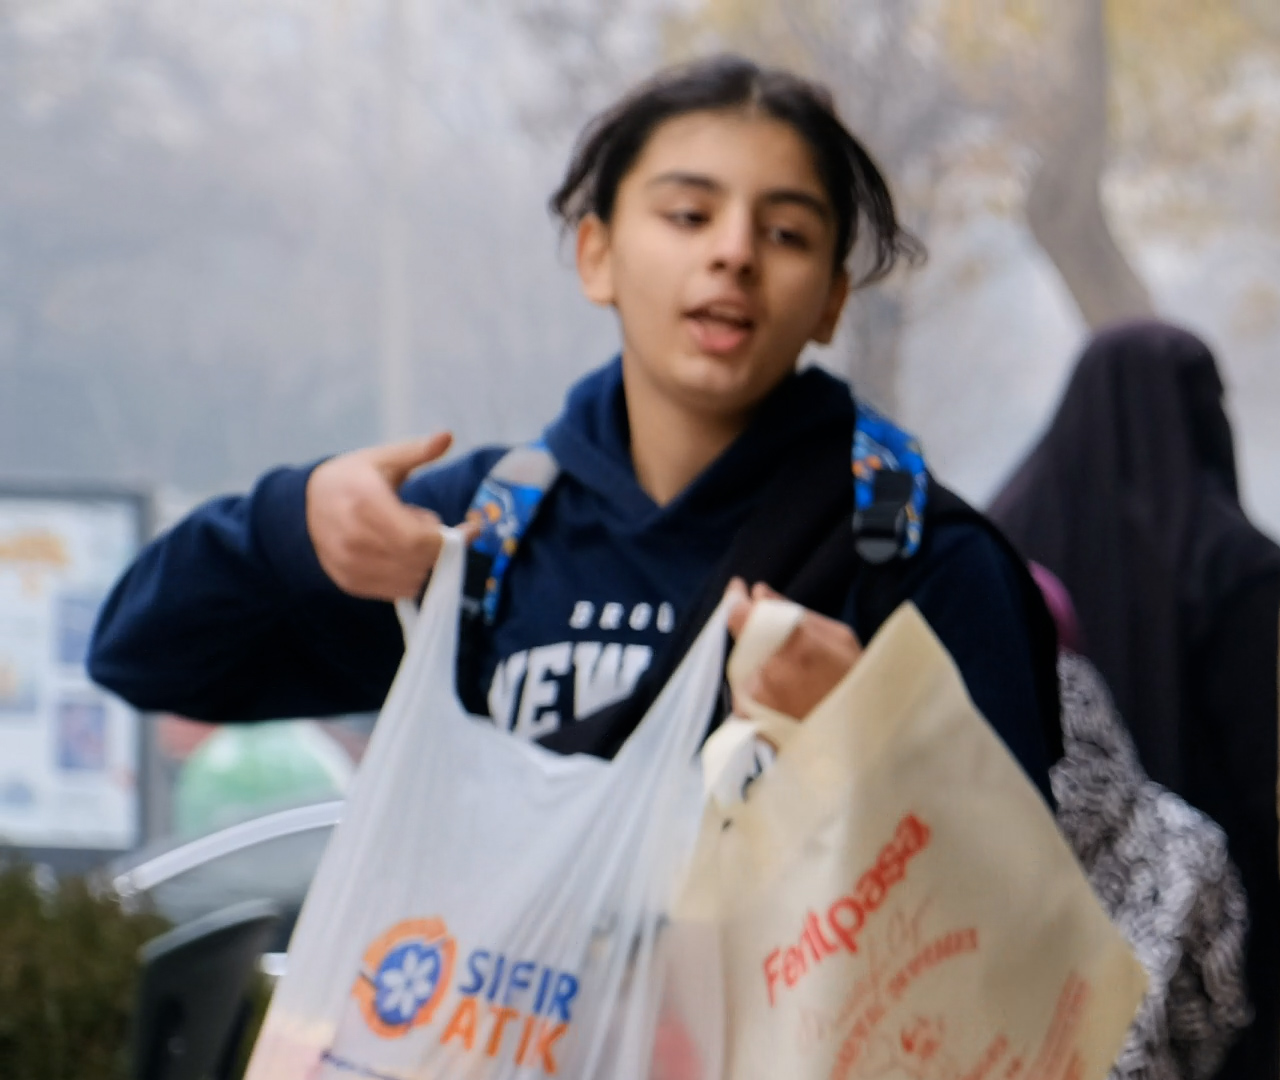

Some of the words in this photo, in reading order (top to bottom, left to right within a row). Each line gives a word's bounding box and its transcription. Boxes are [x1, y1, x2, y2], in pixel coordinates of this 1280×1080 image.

[488, 641, 652, 739] NEW
[459, 949, 579, 1021] SIFIR
[440, 996, 568, 1074] ATIK
